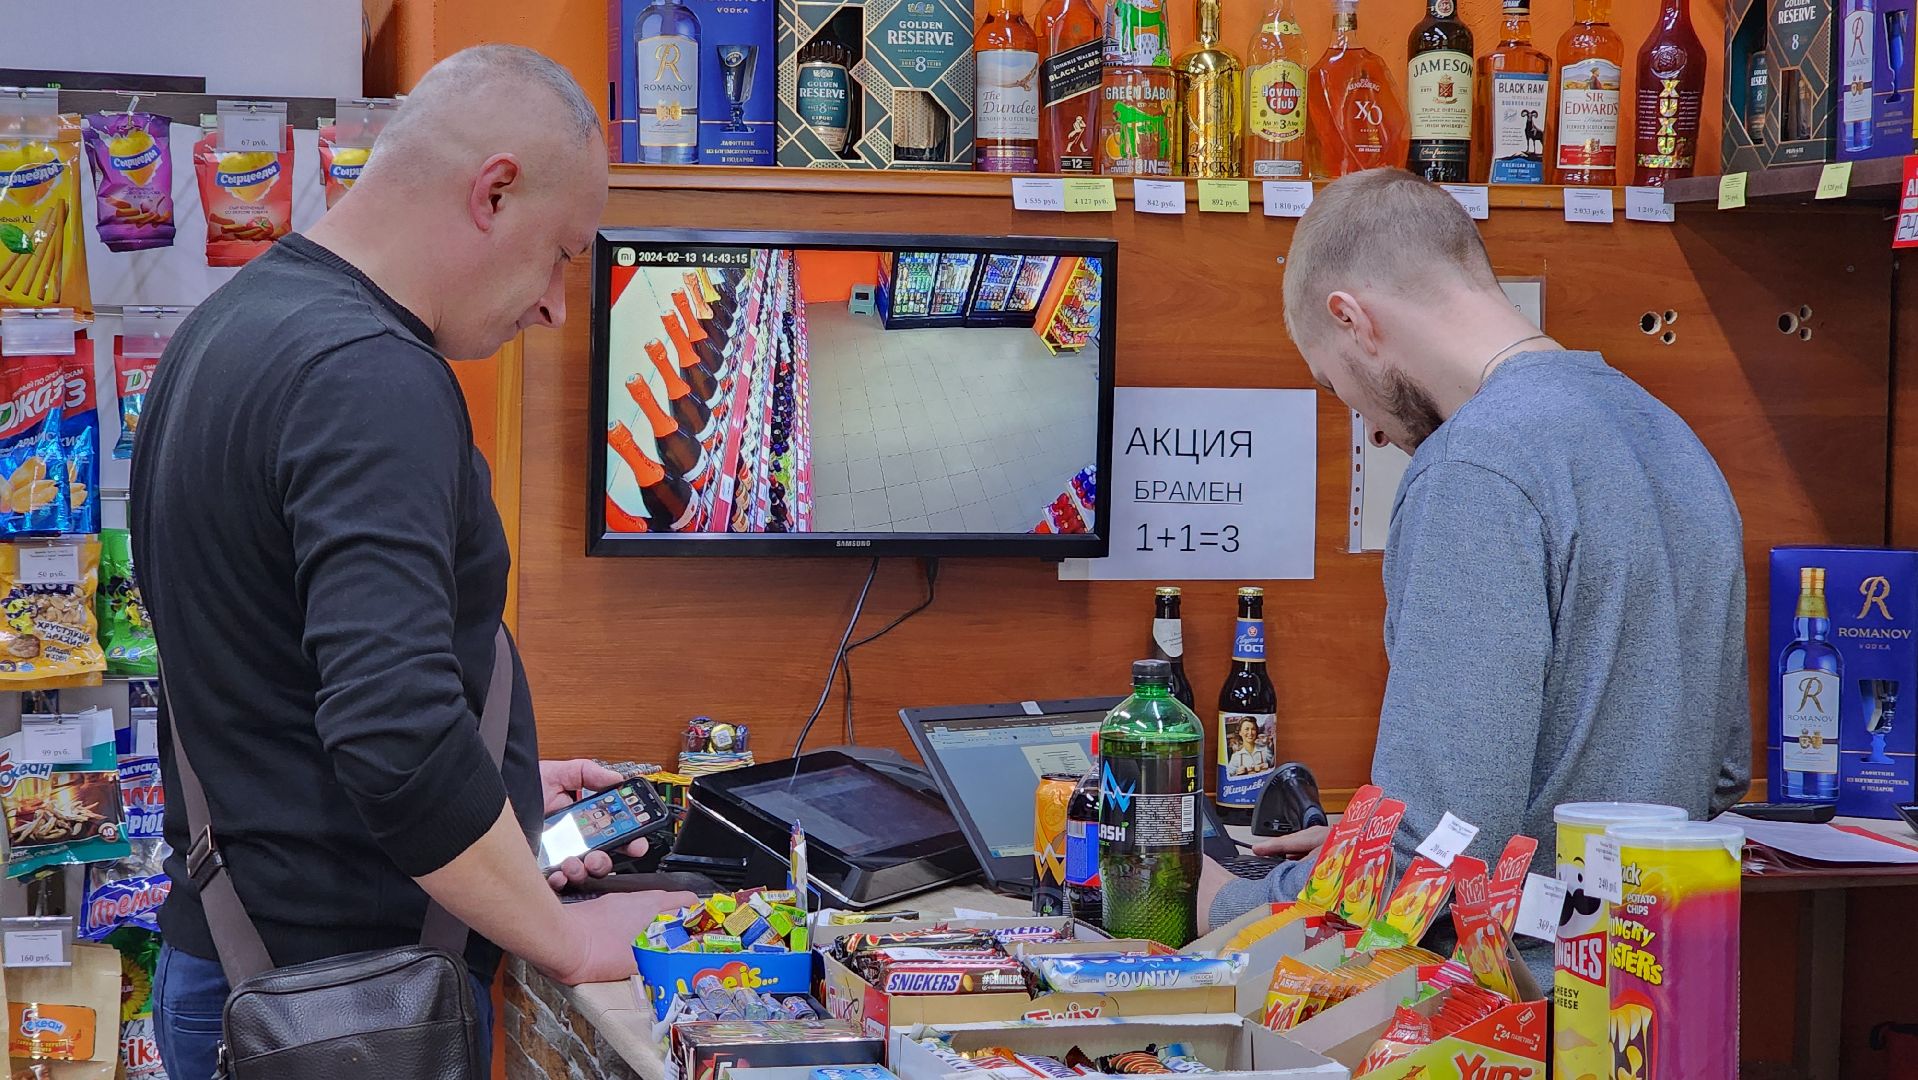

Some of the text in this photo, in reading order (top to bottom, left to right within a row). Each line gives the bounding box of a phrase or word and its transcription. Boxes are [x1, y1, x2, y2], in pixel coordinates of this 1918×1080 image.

[1778, 6, 1816, 24] RESERVE
[899, 21, 943, 30] GOLDEN
[887, 30, 954, 46] RESERVE
[1791, 34, 1799, 49] 8
[915, 56, 926, 72] 8
[1413, 58, 1473, 78] JAMESON
[1048, 67, 1077, 82] BLACK
[643, 84, 694, 92] ROMANOV
[800, 88, 845, 99] RESERVE
[1105, 85, 1141, 100] GREEN
[1262, 85, 1301, 98] Havana
[1498, 82, 1545, 94] BLACK RAM
[983, 91, 1000, 100] The
[1585, 92, 1604, 102] SIR
[819, 103, 827, 113] 8
[983, 100, 1036, 115] Dundee
[1269, 98, 1295, 110] Club
[1279, 120, 1287, 129] 3
[1071, 158, 1083, 168] 12
[220, 165, 278, 185] Сырцееды
[1043, 198, 1057, 206] руб.
[1094, 198, 1109, 206] руб.
[1225, 199, 1239, 207] руб.
[1592, 208, 1606, 216] руб.
[638, 252, 697, 262] 2024-02-13
[702, 253, 748, 264] 14:43:15
[1125, 427, 1252, 464] АКЦИЯ
[1134, 480, 1243, 503] БРАМЕН
[1136, 523, 1240, 552] 1+1=3
[1838, 627, 1912, 640] ROMANOV
[1238, 644, 1264, 653] ГОСТ
[1787, 714, 1834, 723] ROMANOV
[103, 827, 114, 837] 40
[1627, 893, 1657, 905] POTATO
[1627, 904, 1649, 915] CHIPS
[888, 973, 960, 991] SNICKERS
[1105, 969, 1180, 988] BOUNTY
[1500, 1031, 1511, 1039] 24
